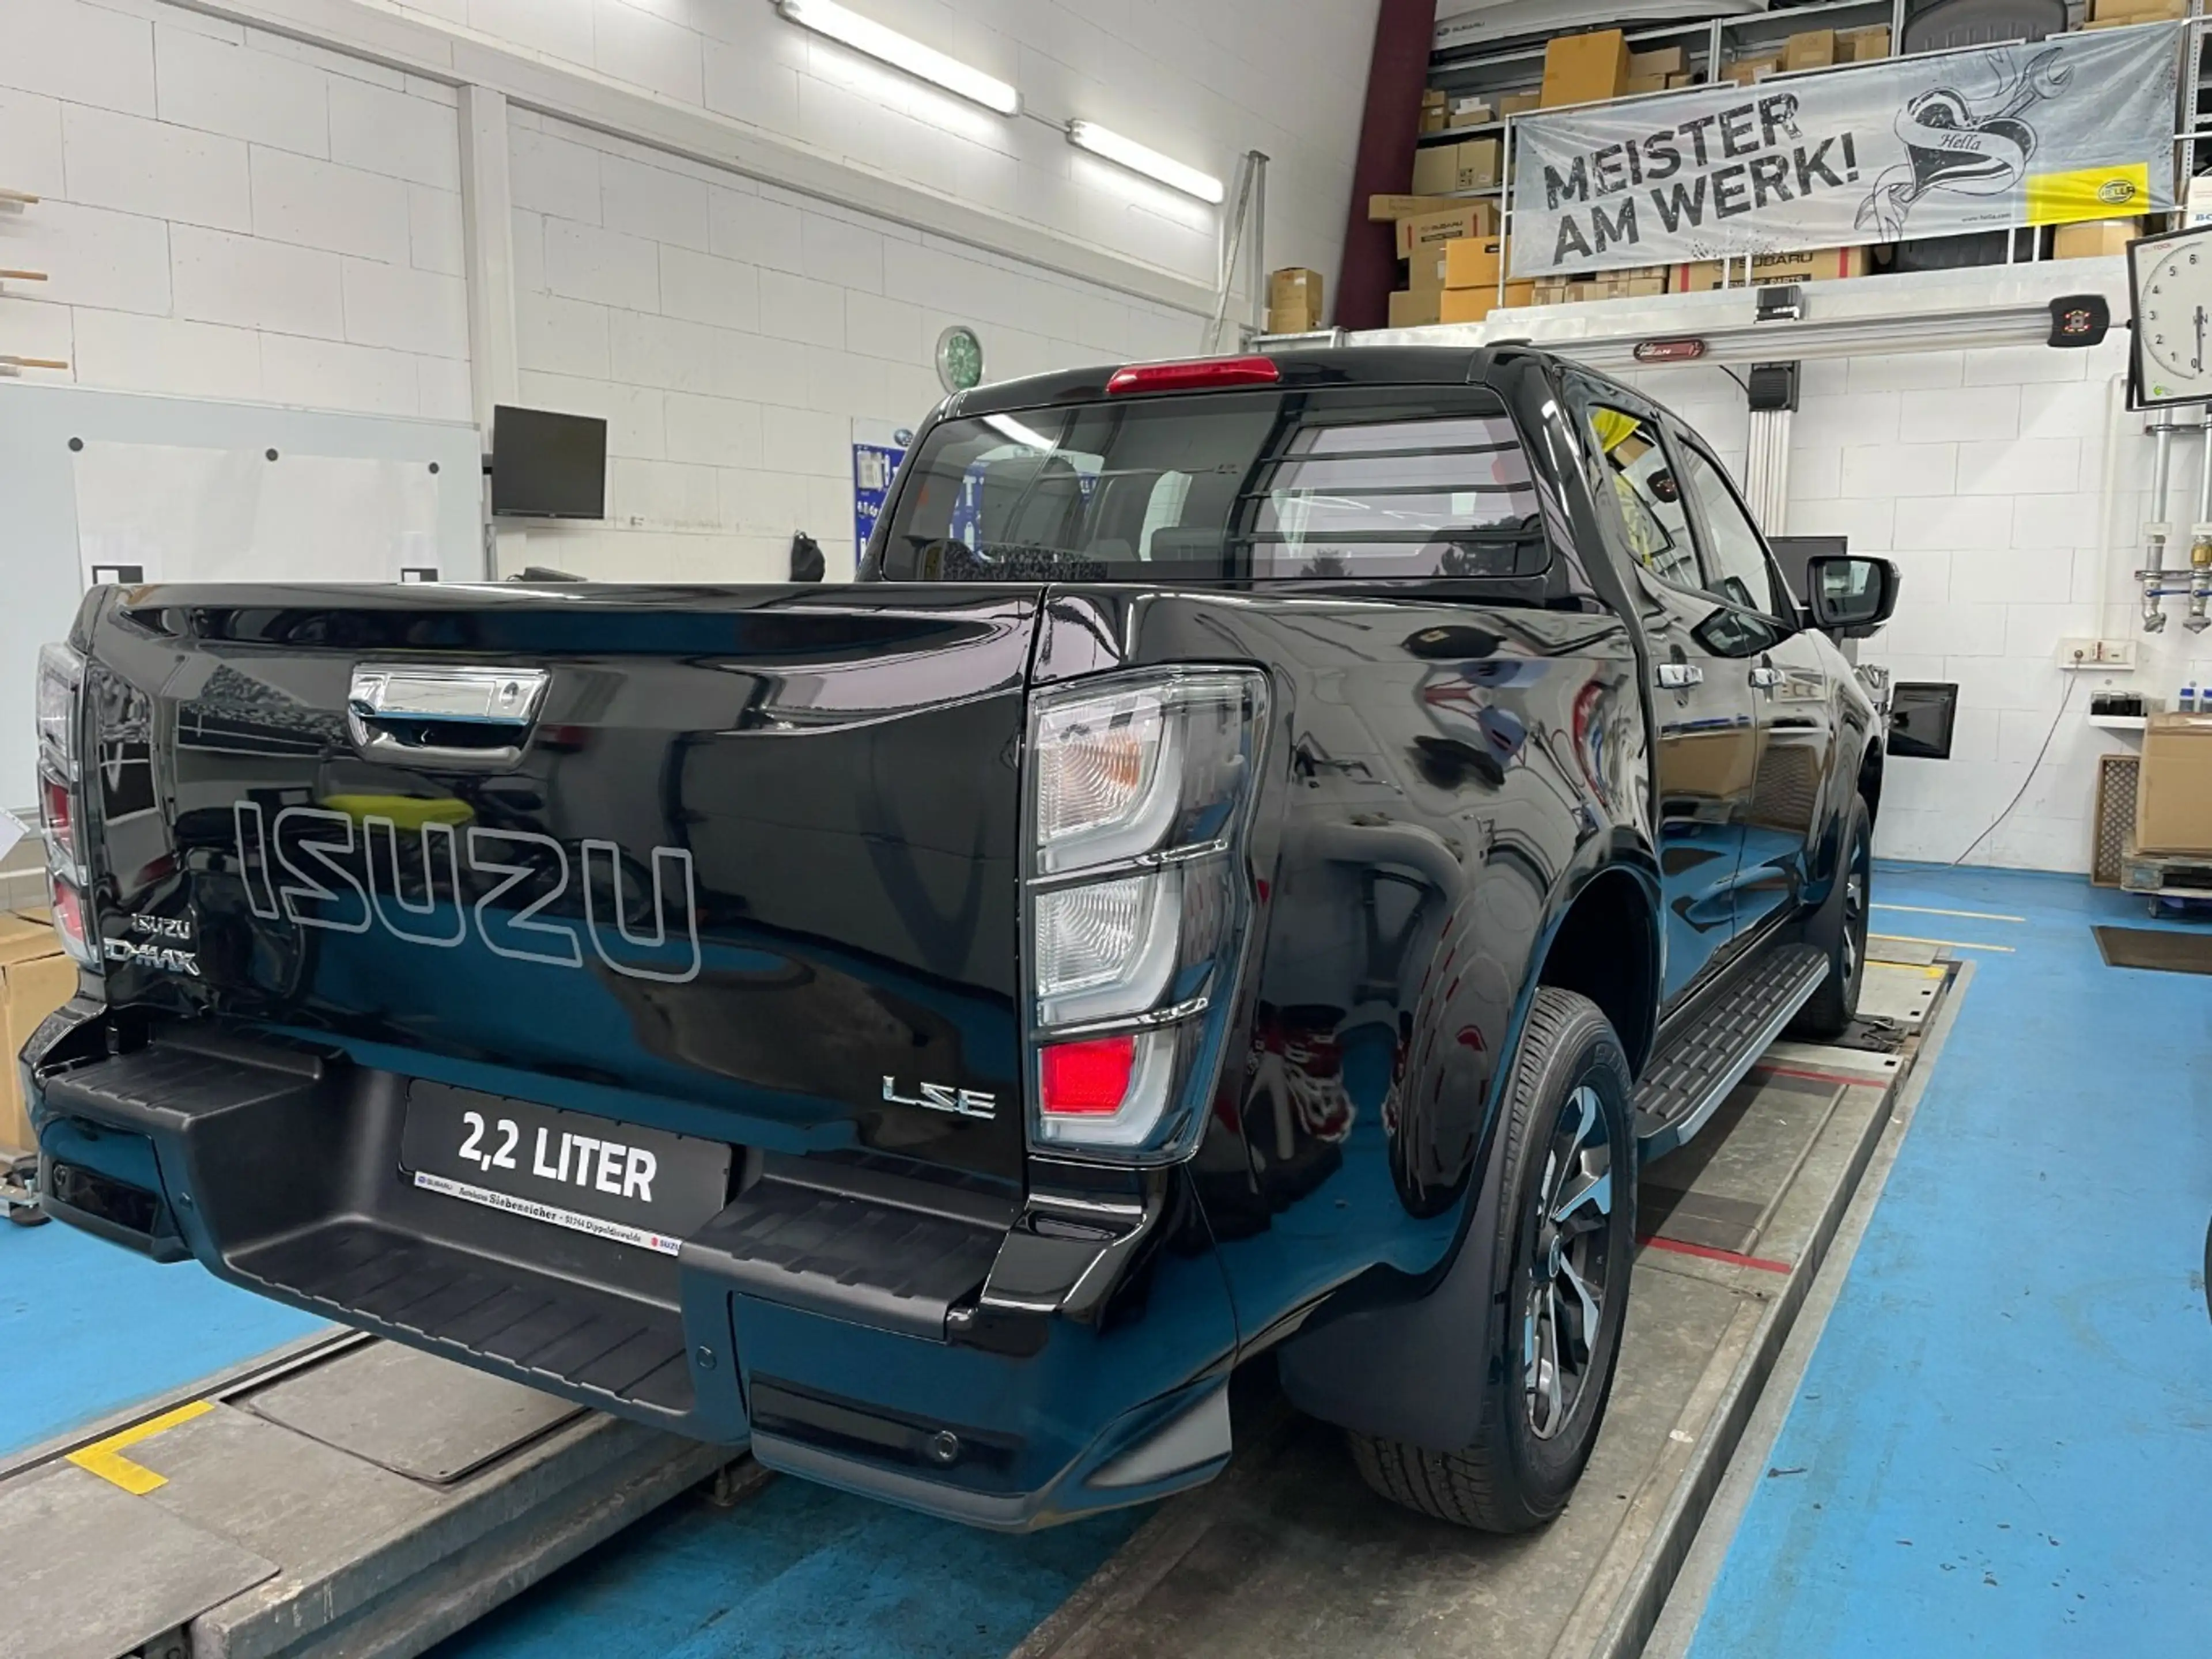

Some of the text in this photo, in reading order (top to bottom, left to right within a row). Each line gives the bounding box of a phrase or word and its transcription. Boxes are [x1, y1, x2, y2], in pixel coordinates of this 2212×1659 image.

[1941, 134, 1982, 151] Hella
[1544, 92, 1802, 210] MEISTER
[2103, 182, 2135, 198] HELLA
[1553, 132, 1859, 266] AM WERK!
[1739, 252, 1813, 268] SUBARU
[2190, 255, 2196, 264] 6
[2169, 266, 2176, 276] 5
[2153, 286, 2159, 294] 4
[2149, 311, 2156, 320] 3
[2156, 334, 2162, 344] 2
[2170, 353, 2175, 362] 1
[2191, 358, 2197, 369] 0
[234, 800, 702, 983] ISUZU
[131, 912, 191, 940] ISUZU
[883, 1075, 996, 1120] LSE
[459, 1111, 657, 1202] 2,2 LITER
